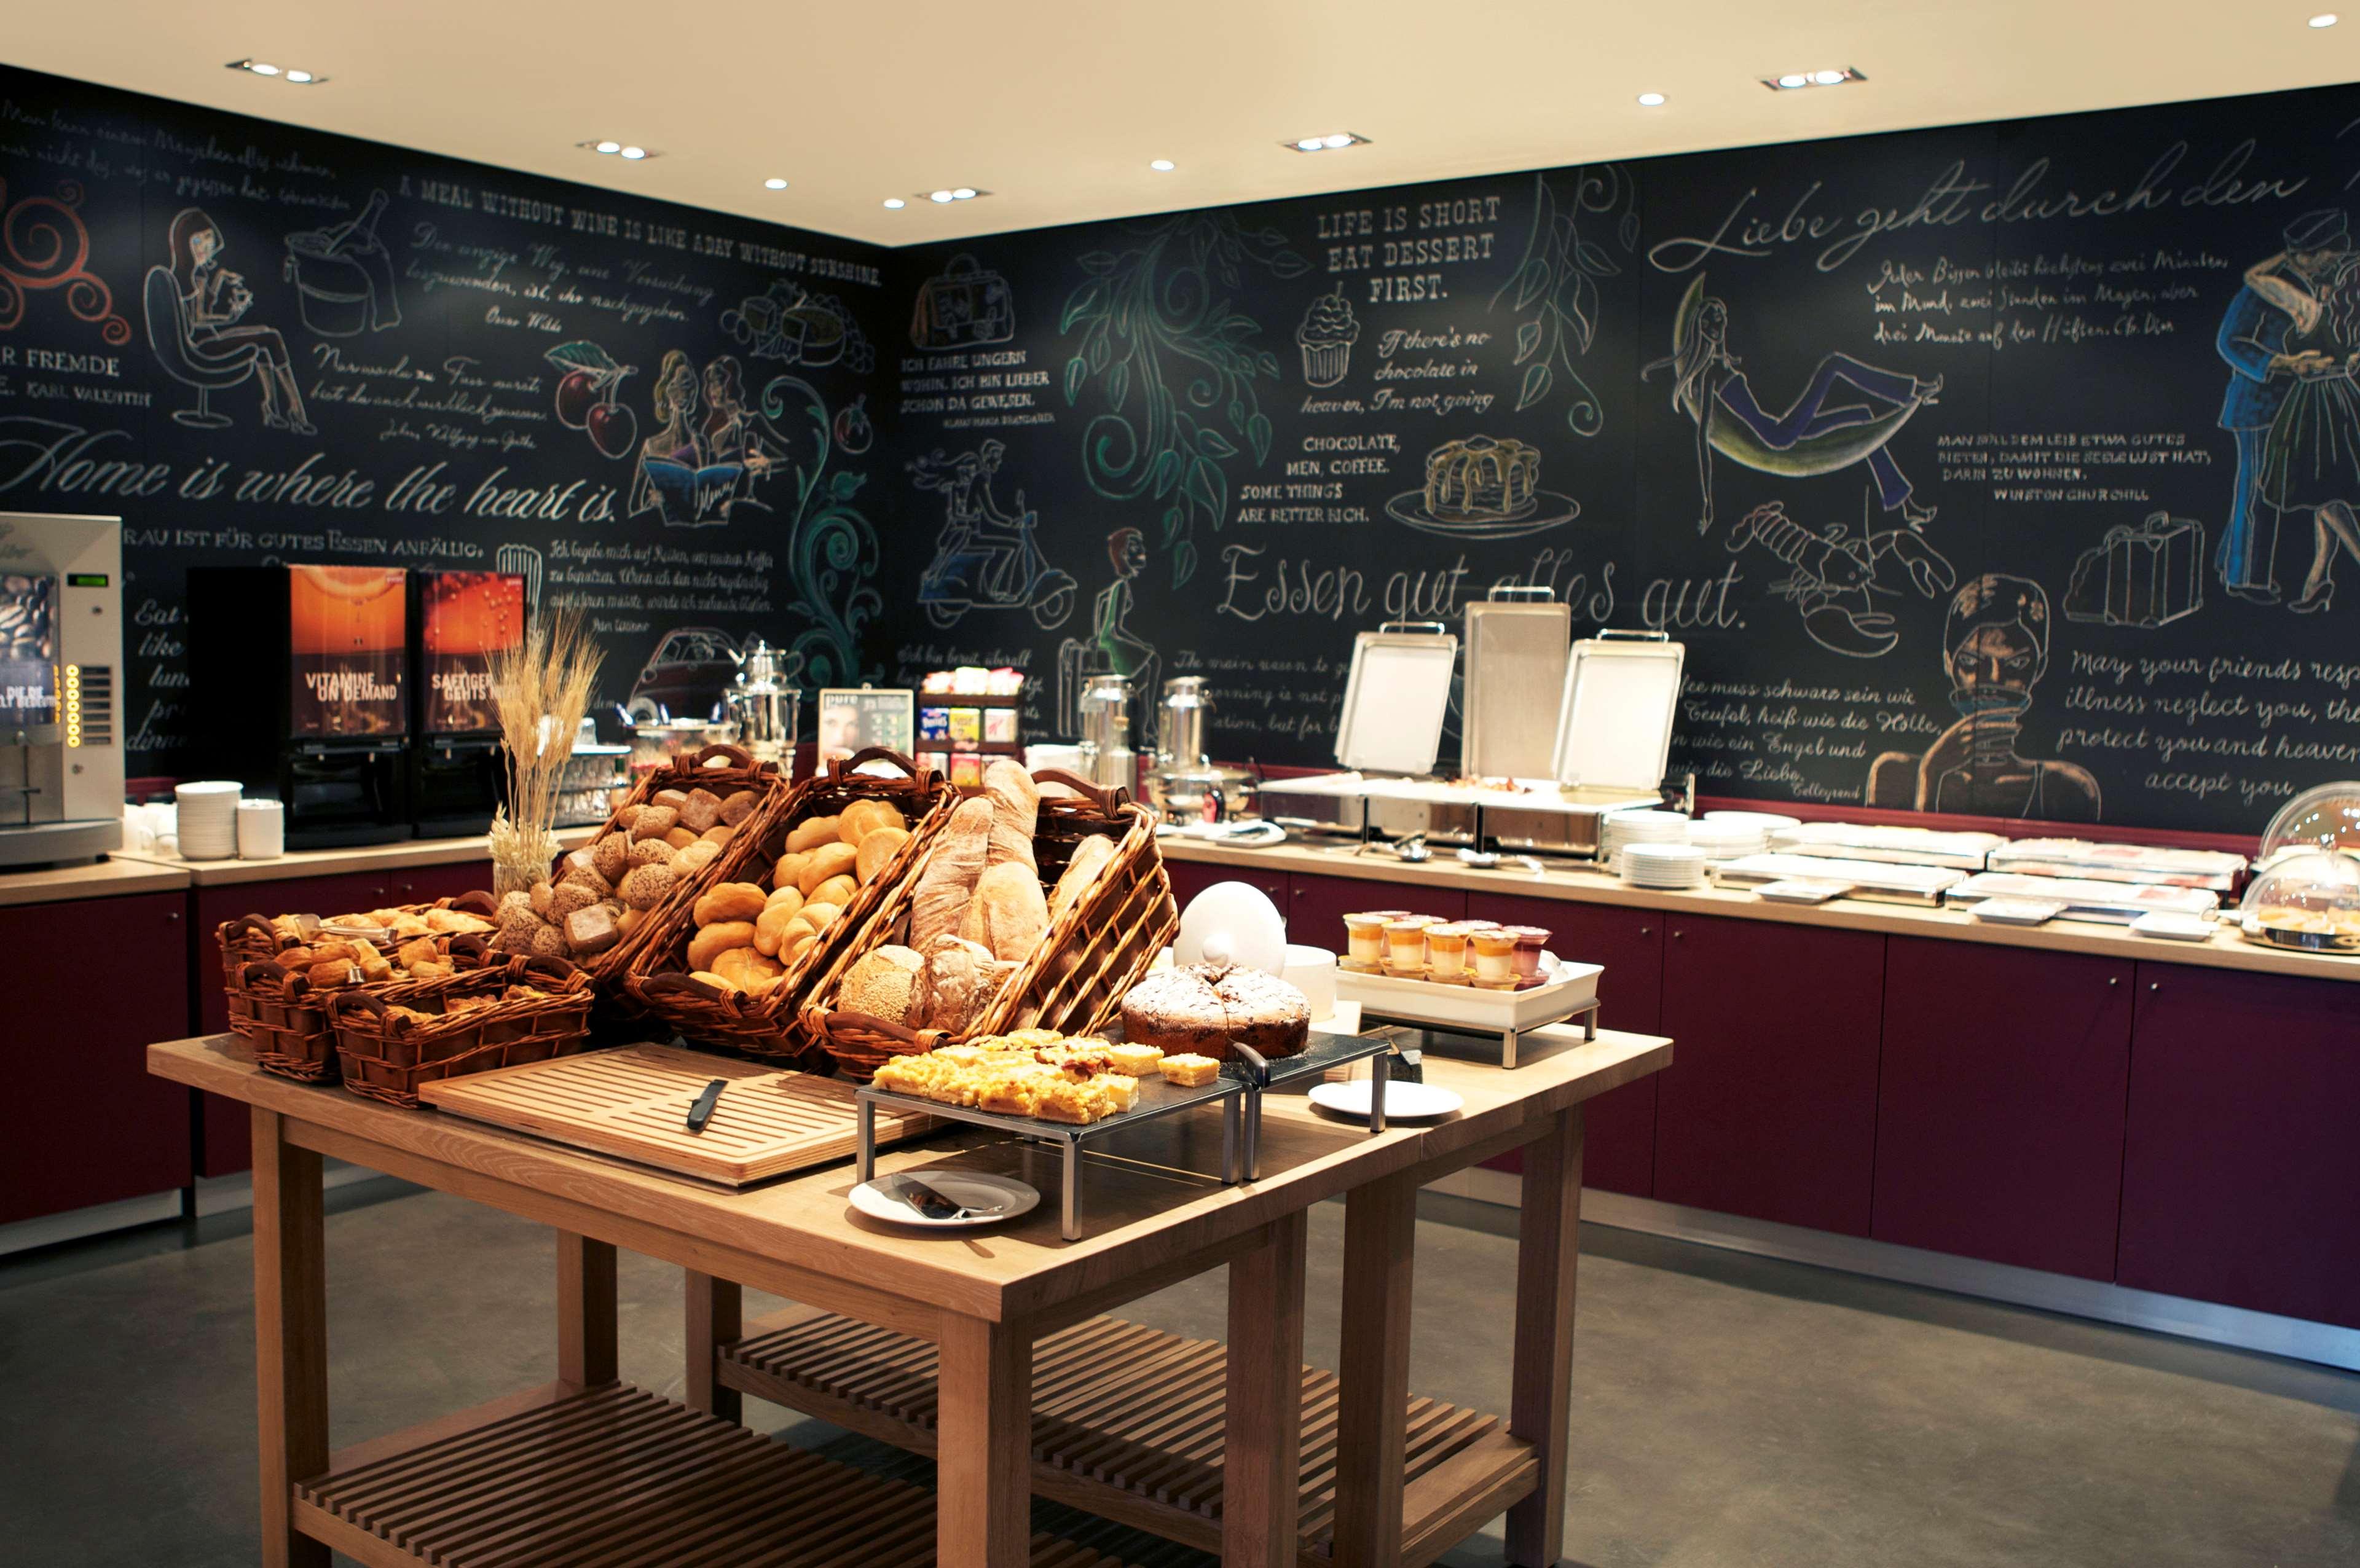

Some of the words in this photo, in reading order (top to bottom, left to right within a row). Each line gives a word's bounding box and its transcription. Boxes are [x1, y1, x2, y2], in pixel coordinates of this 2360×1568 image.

[1648, 180, 1844, 273] Liebe
[1815, 157, 1992, 273] geht
[1979, 138, 2189, 224] durch
[2179, 137, 2311, 207] den
[399, 174, 413, 197] A
[421, 179, 474, 210] MEAL
[481, 190, 565, 226] WITHOUT
[570, 208, 619, 237] WINE
[623, 218, 642, 240] IS
[647, 222, 687, 249] LIKE
[693, 233, 704, 253] A
[704, 236, 735, 259] DAY
[739, 241, 807, 272] WITHOUT
[1316, 210, 1374, 240] LIFE
[1382, 206, 1407, 233] IS
[1417, 195, 1501, 230] SHORT
[1327, 245, 1374, 273] EAT
[1383, 232, 1495, 268] DESSERT
[1367, 273, 1449, 304] FIRST.
[1465, 332, 1492, 346] no
[26, 348, 120, 378] FREMDE
[901, 358, 924, 372] ICH
[927, 354, 969, 371] FAHRE
[971, 350, 1027, 368] UNGERN
[1374, 358, 1457, 381] chocolate
[1460, 358, 1479, 377] in
[952, 375, 976, 390] ICH
[978, 373, 1002, 388] BIN
[1005, 370, 1050, 388] LIEBER
[26, 382, 65, 401] KARL
[73, 385, 152, 408] VALENTIN
[900, 396, 945, 414] SCHON
[946, 395, 968, 412] DA
[1409, 393, 1439, 409] not
[1937, 434, 1973, 447] MAN
[2130, 433, 2186, 447] GUTES
[1999, 450, 2051, 465] DAMIT
[2054, 450, 2080, 464] DIE
[0, 415, 173, 496] Home
[178, 455, 232, 501] is
[234, 452, 376, 510] where
[384, 460, 458, 516] the
[463, 465, 589, 523] heart
[577, 484, 618, 525] is.
[1942, 467, 1987, 482] DARIN
[1991, 467, 2014, 481] ZU
[1239, 483, 1283, 501] SOME
[1284, 482, 1344, 500] THINGS
[1993, 488, 2064, 502] WINSTON
[2065, 488, 2150, 502] CHURCHILL
[1237, 507, 1267, 523] ARE
[1269, 504, 1325, 523] BETTER
[175, 528, 211, 548] IST
[214, 525, 255, 551] FÜR
[256, 530, 324, 552] GUTES
[1216, 543, 1372, 622] Essen
[1384, 554, 1471, 633] gut
[138, 631, 186, 658] like
[2071, 649, 2133, 686] May
[2139, 656, 2203, 686] your
[2207, 655, 2302, 684] friends
[305, 672, 375, 689] VITAMINE
[317, 684, 339, 702] ON
[344, 683, 397, 702] DEMAND
[1710, 682, 1761, 697] muss
[1763, 677, 1841, 701] schwarz
[1844, 686, 1881, 705] sein
[1886, 686, 1917, 705] wie
[2064, 686, 2149, 715] illness
[2152, 689, 2251, 727] neglect
[1803, 712, 1836, 729] wie
[1841, 711, 1869, 731] die
[1728, 735, 1755, 751] ein
[1828, 740, 1867, 759] und
[2055, 726, 2150, 754] protect
[2155, 735, 2212, 764] you
[2212, 734, 2269, 759] and
[1706, 759, 1733, 778] die
[2144, 771, 2234, 800] accept
